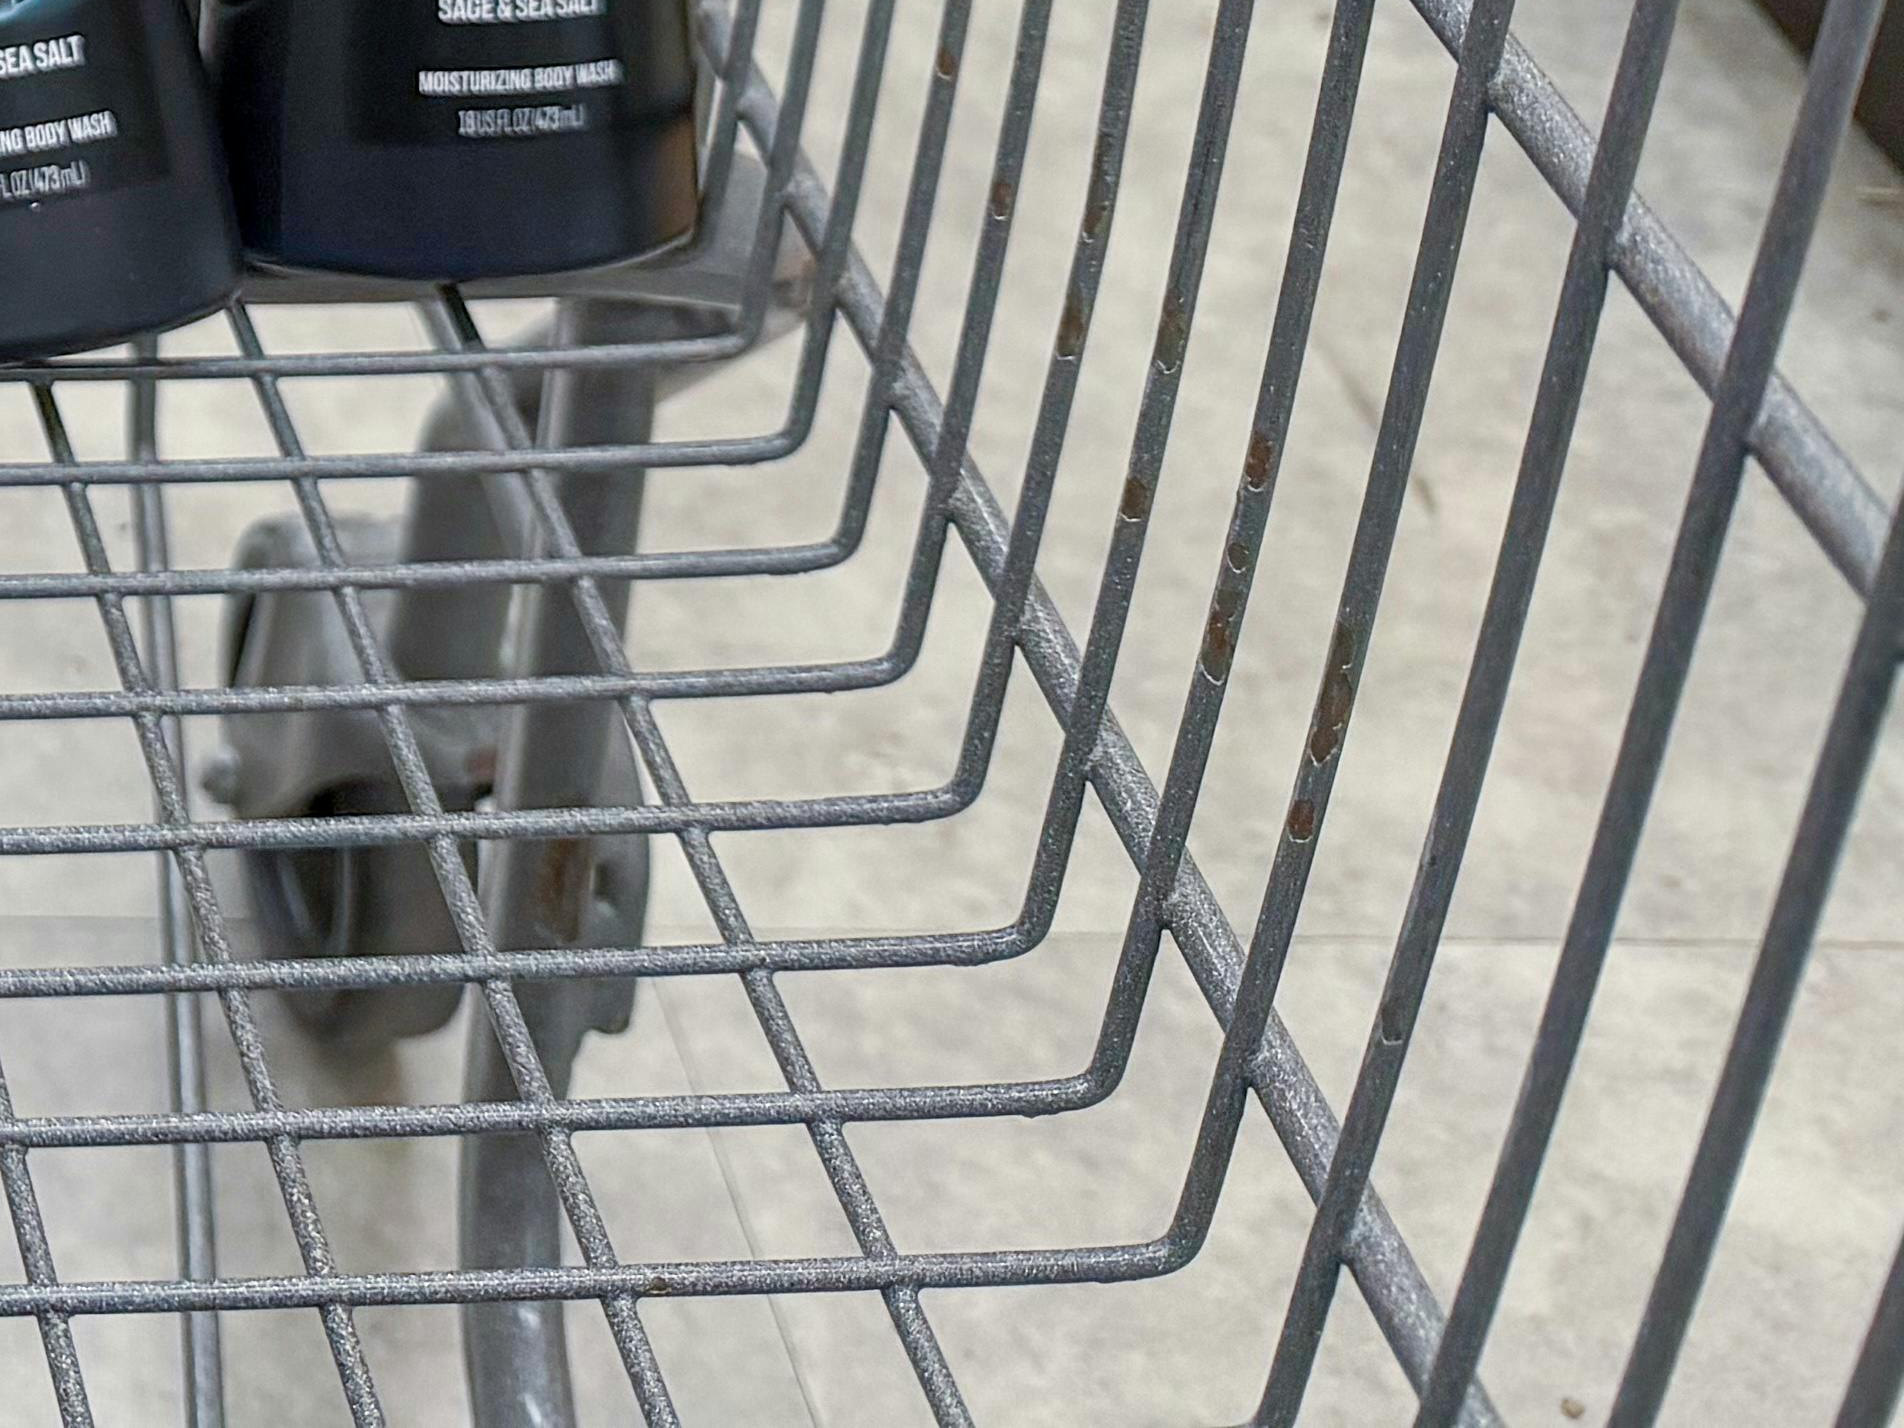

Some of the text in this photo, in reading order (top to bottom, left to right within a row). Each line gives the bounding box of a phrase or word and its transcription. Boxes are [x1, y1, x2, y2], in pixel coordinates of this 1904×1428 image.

[35, 33, 85, 69] SALT
[418, 59, 621, 96] MOISTURIZING BODY WASH
[23, 119, 67, 152] BODY
[68, 109, 118, 145] WASH
